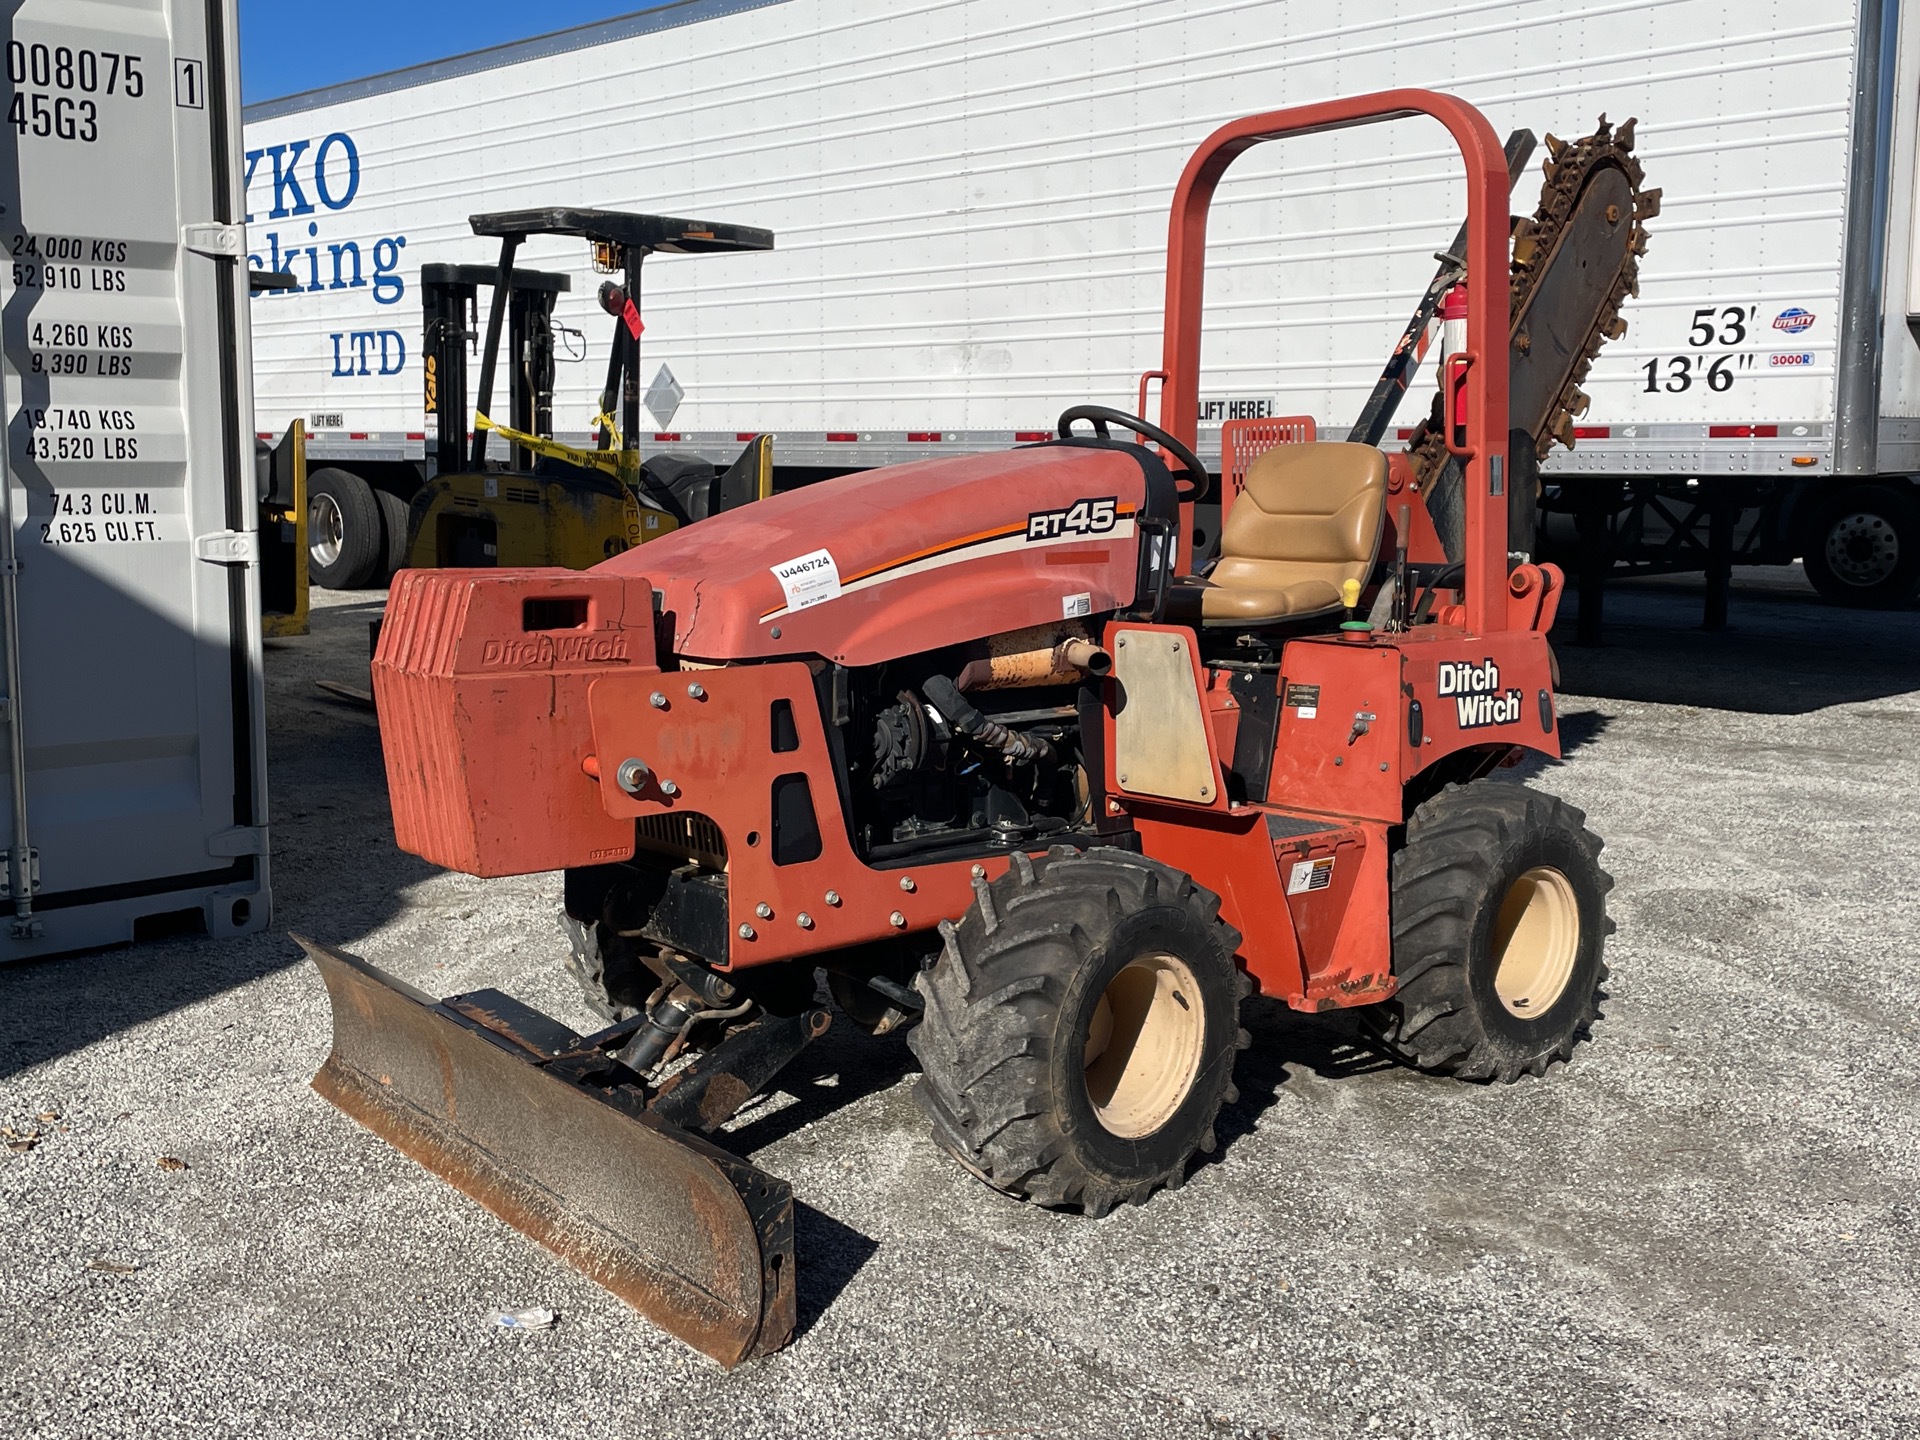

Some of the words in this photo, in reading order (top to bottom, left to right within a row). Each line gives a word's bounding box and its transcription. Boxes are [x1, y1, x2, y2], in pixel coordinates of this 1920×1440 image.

[6, 40, 144, 98] 008075
[183, 63, 195, 105] 1
[7, 92, 98, 142] 45G3
[13, 234, 83, 260] 24,000
[91, 239, 128, 263] KGS
[13, 263, 82, 290] 52,910
[91, 268, 126, 292] LBS
[32, 322, 88, 349] 4,260
[97, 325, 133, 348] KGS
[1688, 305, 1757, 347] 53'
[1774, 315, 1815, 328] UTILITY
[31, 352, 88, 376] 9,390
[97, 355, 132, 376] LBS
[330, 330, 406, 377] LTD
[1772, 354, 1810, 365] 3000R
[425, 354, 437, 412] Yale
[1641, 353, 1755, 394] 13'6"
[23, 408, 91, 432] 19,740
[98, 409, 136, 430] KGS
[314, 414, 325, 427] LIFT
[326, 414, 340, 427] HERE
[1197, 401, 1225, 420] LIFT
[1229, 400, 1265, 420] HERE
[26, 436, 94, 462] 43,520
[104, 437, 138, 460] LBS
[49, 493, 92, 516] 74.3
[101, 492, 157, 515] CU.M.
[1029, 500, 1115, 537] RT45
[40, 522, 97, 547] 2,625
[104, 521, 162, 542] CU.FT.
[779, 556, 830, 579] U446724
[482, 635, 554, 666] Ditch
[557, 633, 628, 661] Witch
[1439, 660, 1498, 695] Ditch
[1457, 691, 1519, 727] Witch
